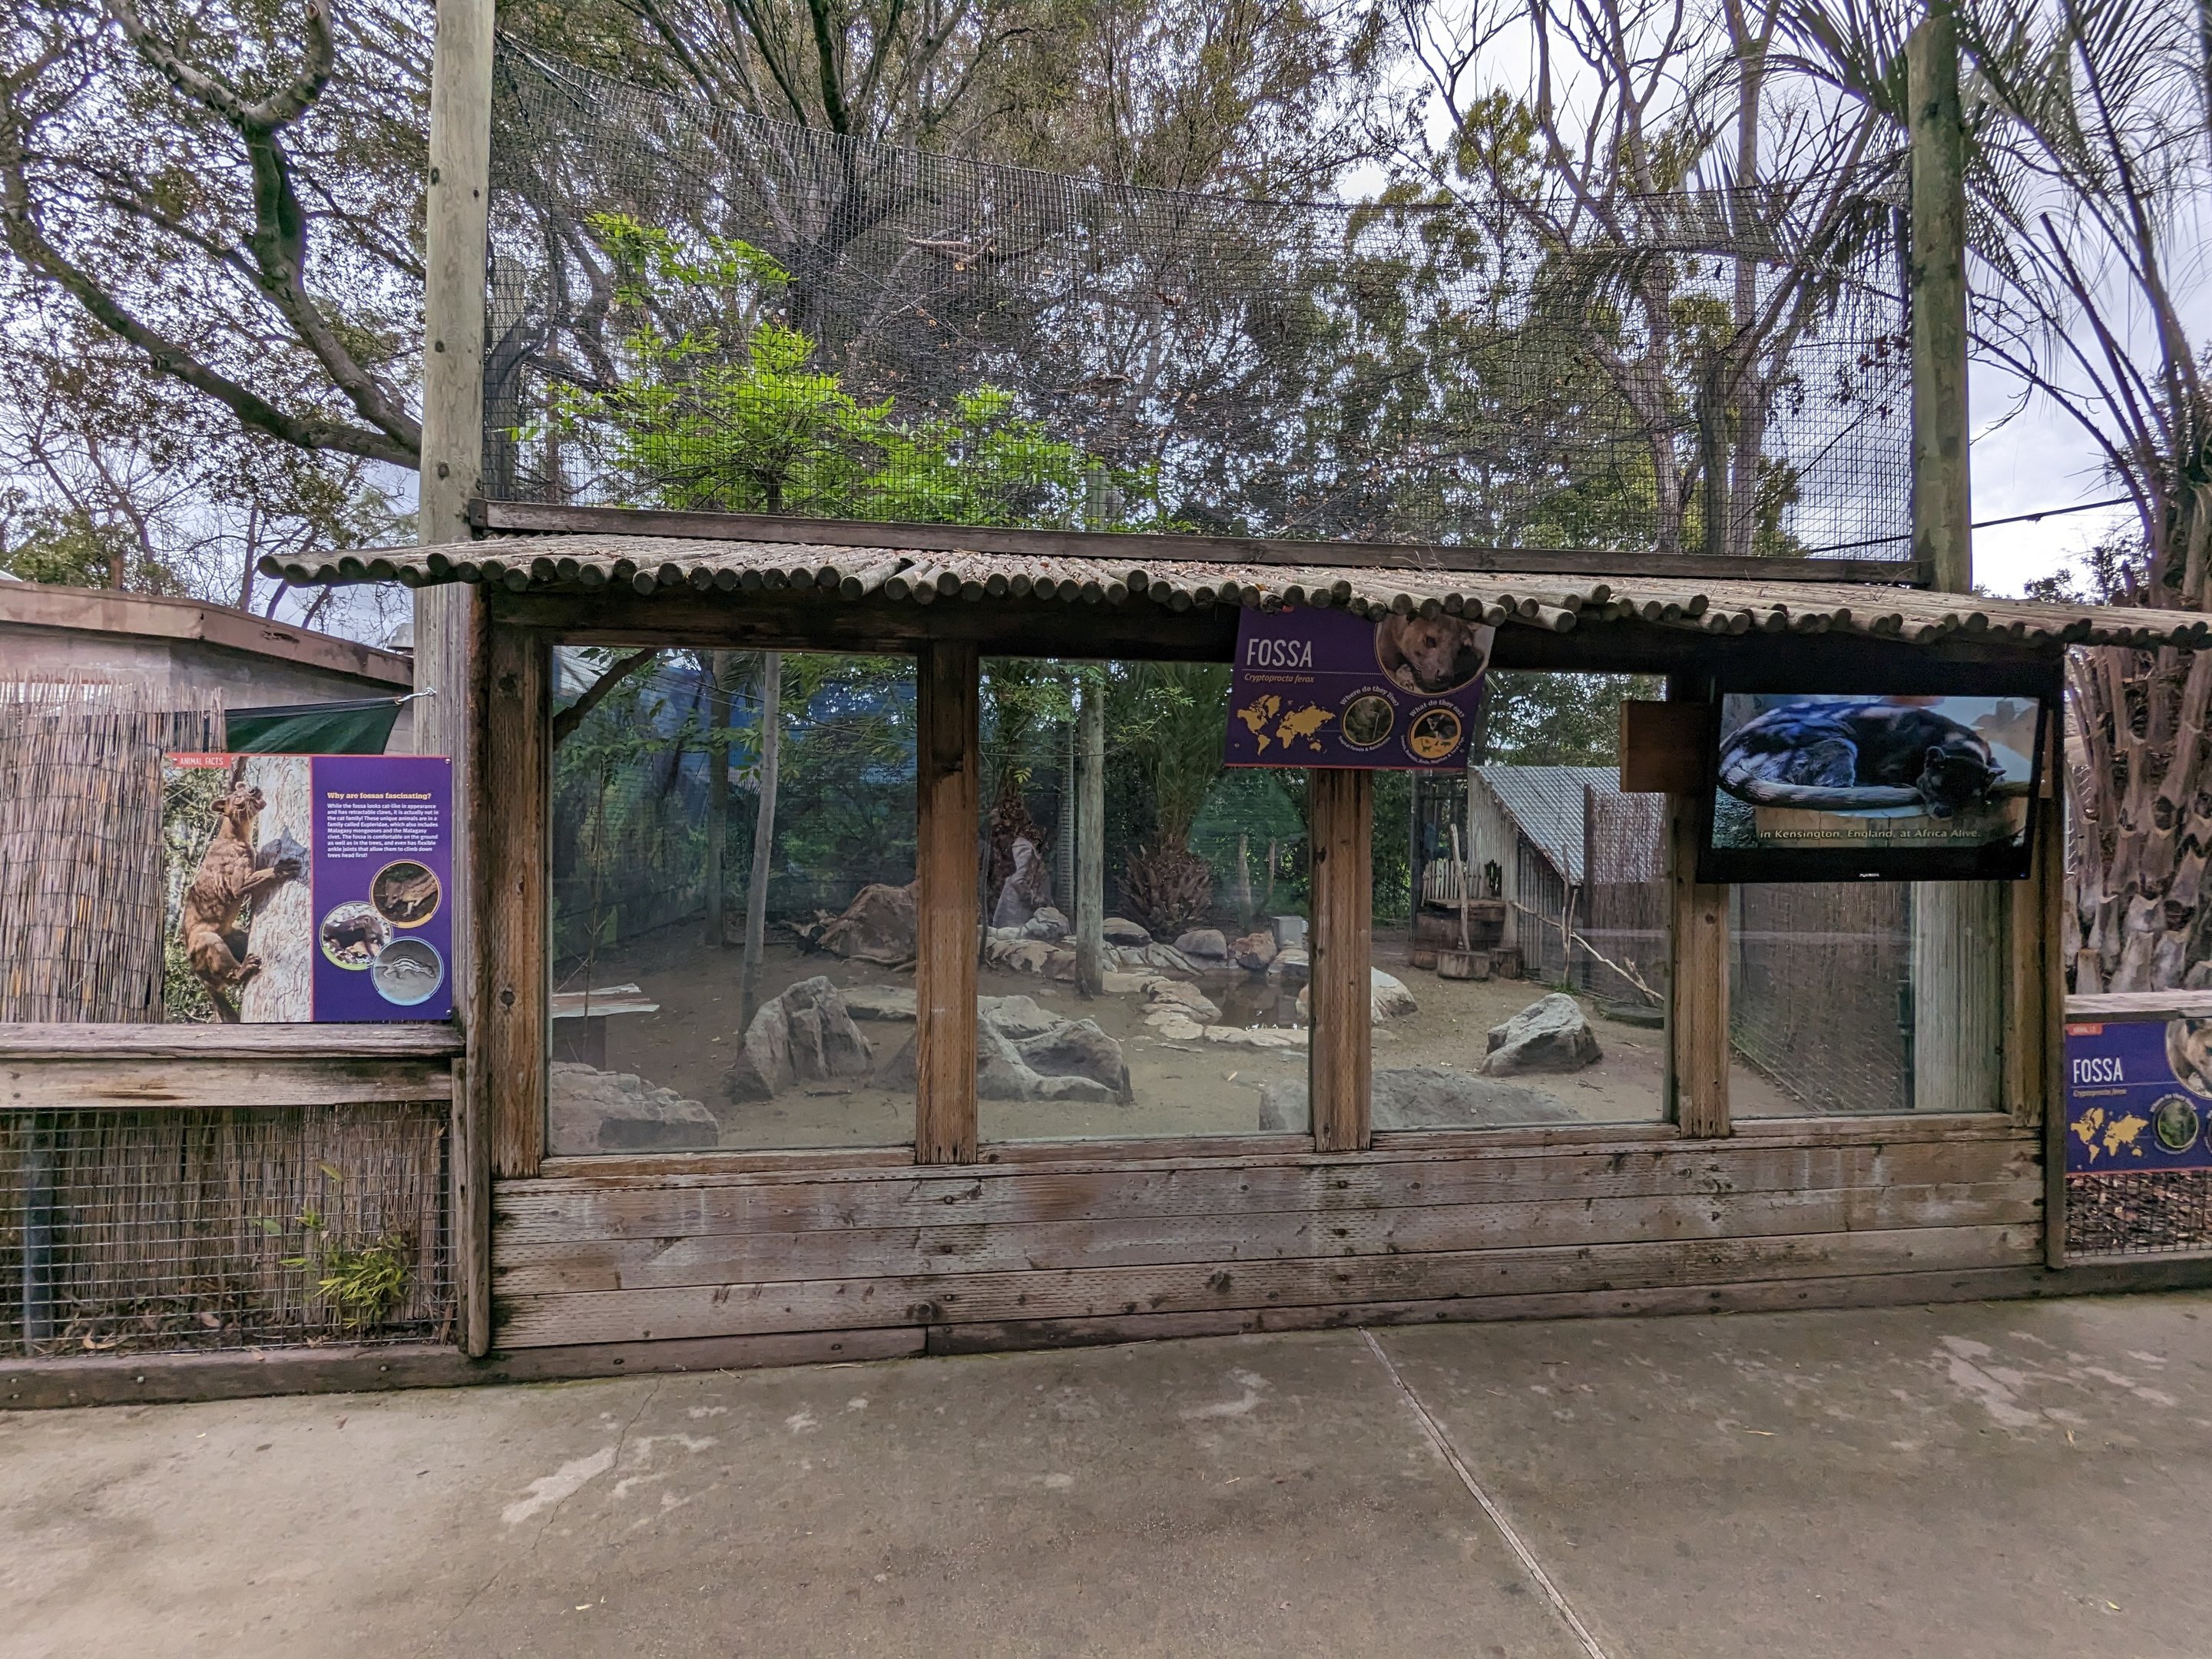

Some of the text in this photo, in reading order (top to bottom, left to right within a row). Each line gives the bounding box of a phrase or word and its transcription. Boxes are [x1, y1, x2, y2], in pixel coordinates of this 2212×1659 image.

[1247, 638, 1312, 667] FOSSA
[1244, 673, 1315, 684] Cryptoprocta ferox
[1340, 689, 1361, 705] Where
[1372, 686, 1387, 695] they
[1386, 692, 1399, 706] live?
[1409, 703, 1427, 717] What
[1439, 699, 1453, 707] they
[1453, 706, 1464, 717] eat?
[1760, 830, 1770, 838] in
[2073, 1058, 2123, 1083] FOSSA
